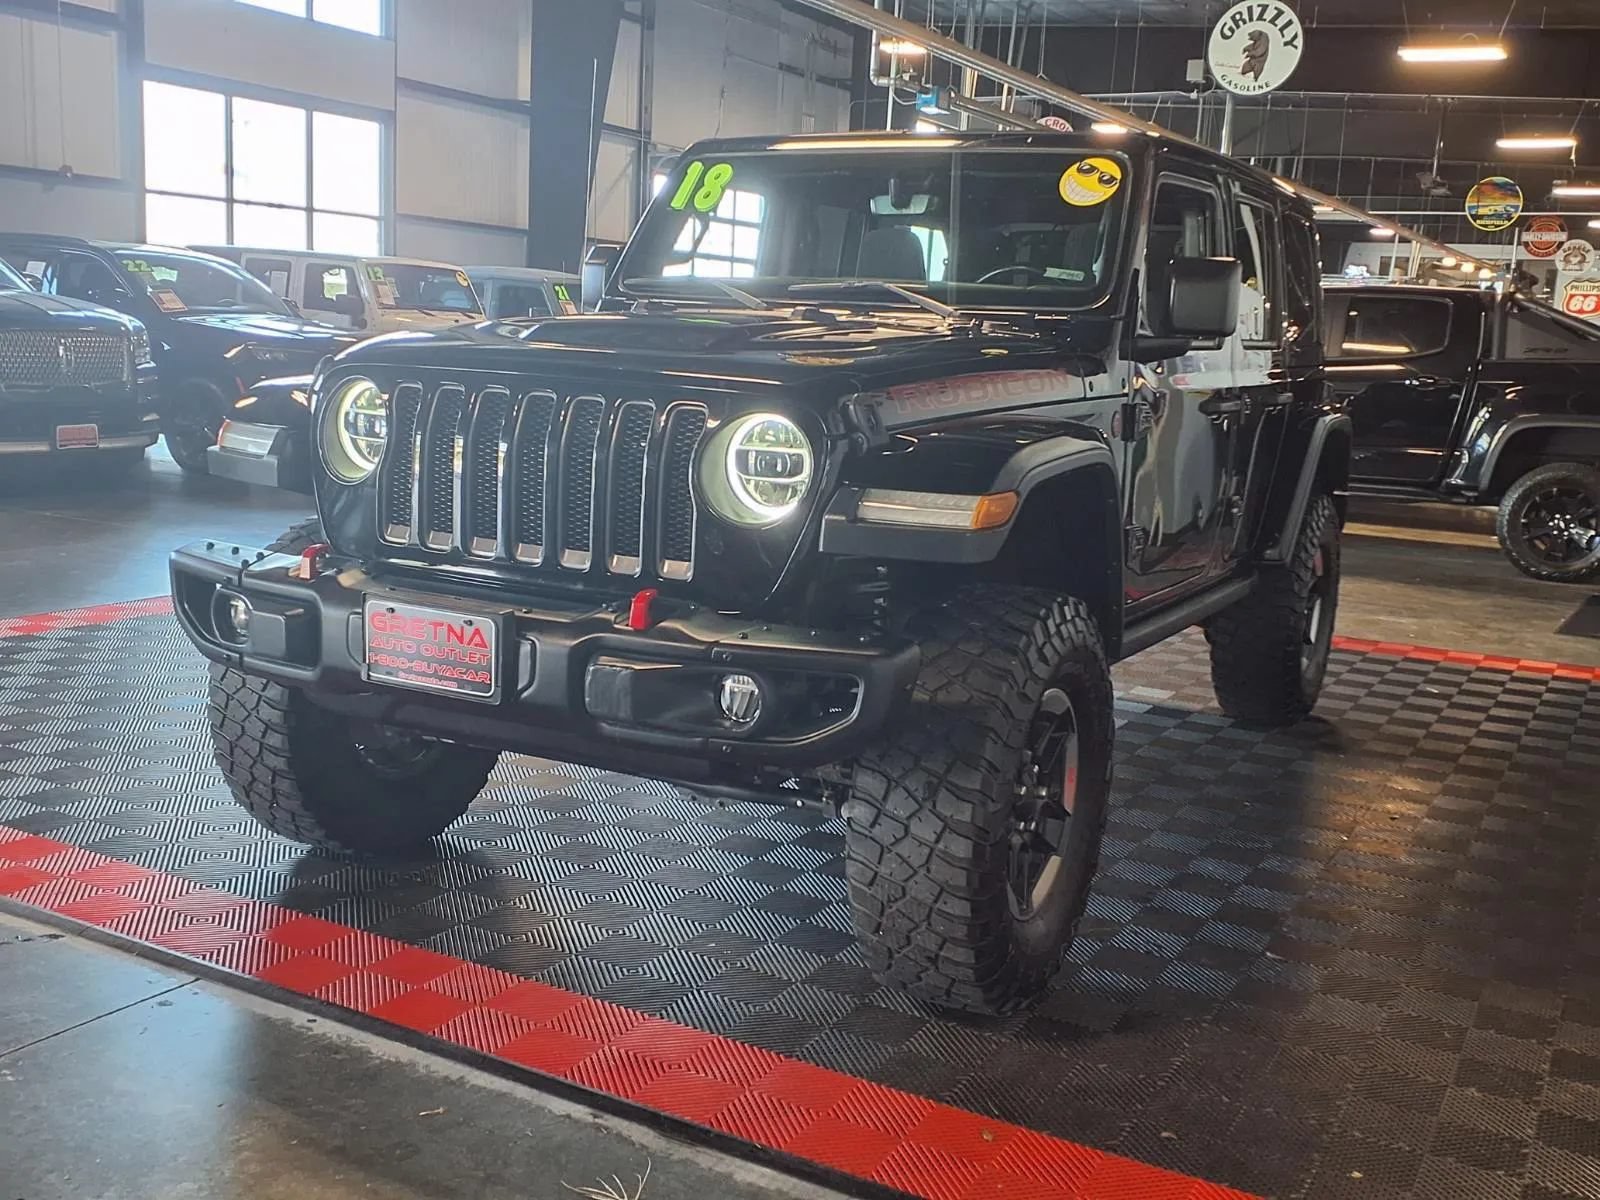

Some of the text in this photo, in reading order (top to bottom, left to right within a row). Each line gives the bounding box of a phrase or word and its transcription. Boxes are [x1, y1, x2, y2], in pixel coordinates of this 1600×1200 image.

[1220, 4, 1299, 50] GRIZZLY
[1220, 74, 1272, 92] GASOLINE
[670, 161, 733, 212] 18
[122, 260, 152, 272] 22
[1568, 295, 1597, 311] 66
[890, 369, 1069, 414] RUBICON
[370, 611, 489, 650] GRETNA
[370, 634, 491, 666] AUTO OUTLET
[369, 652, 491, 684] 1-800-BUYACAR
